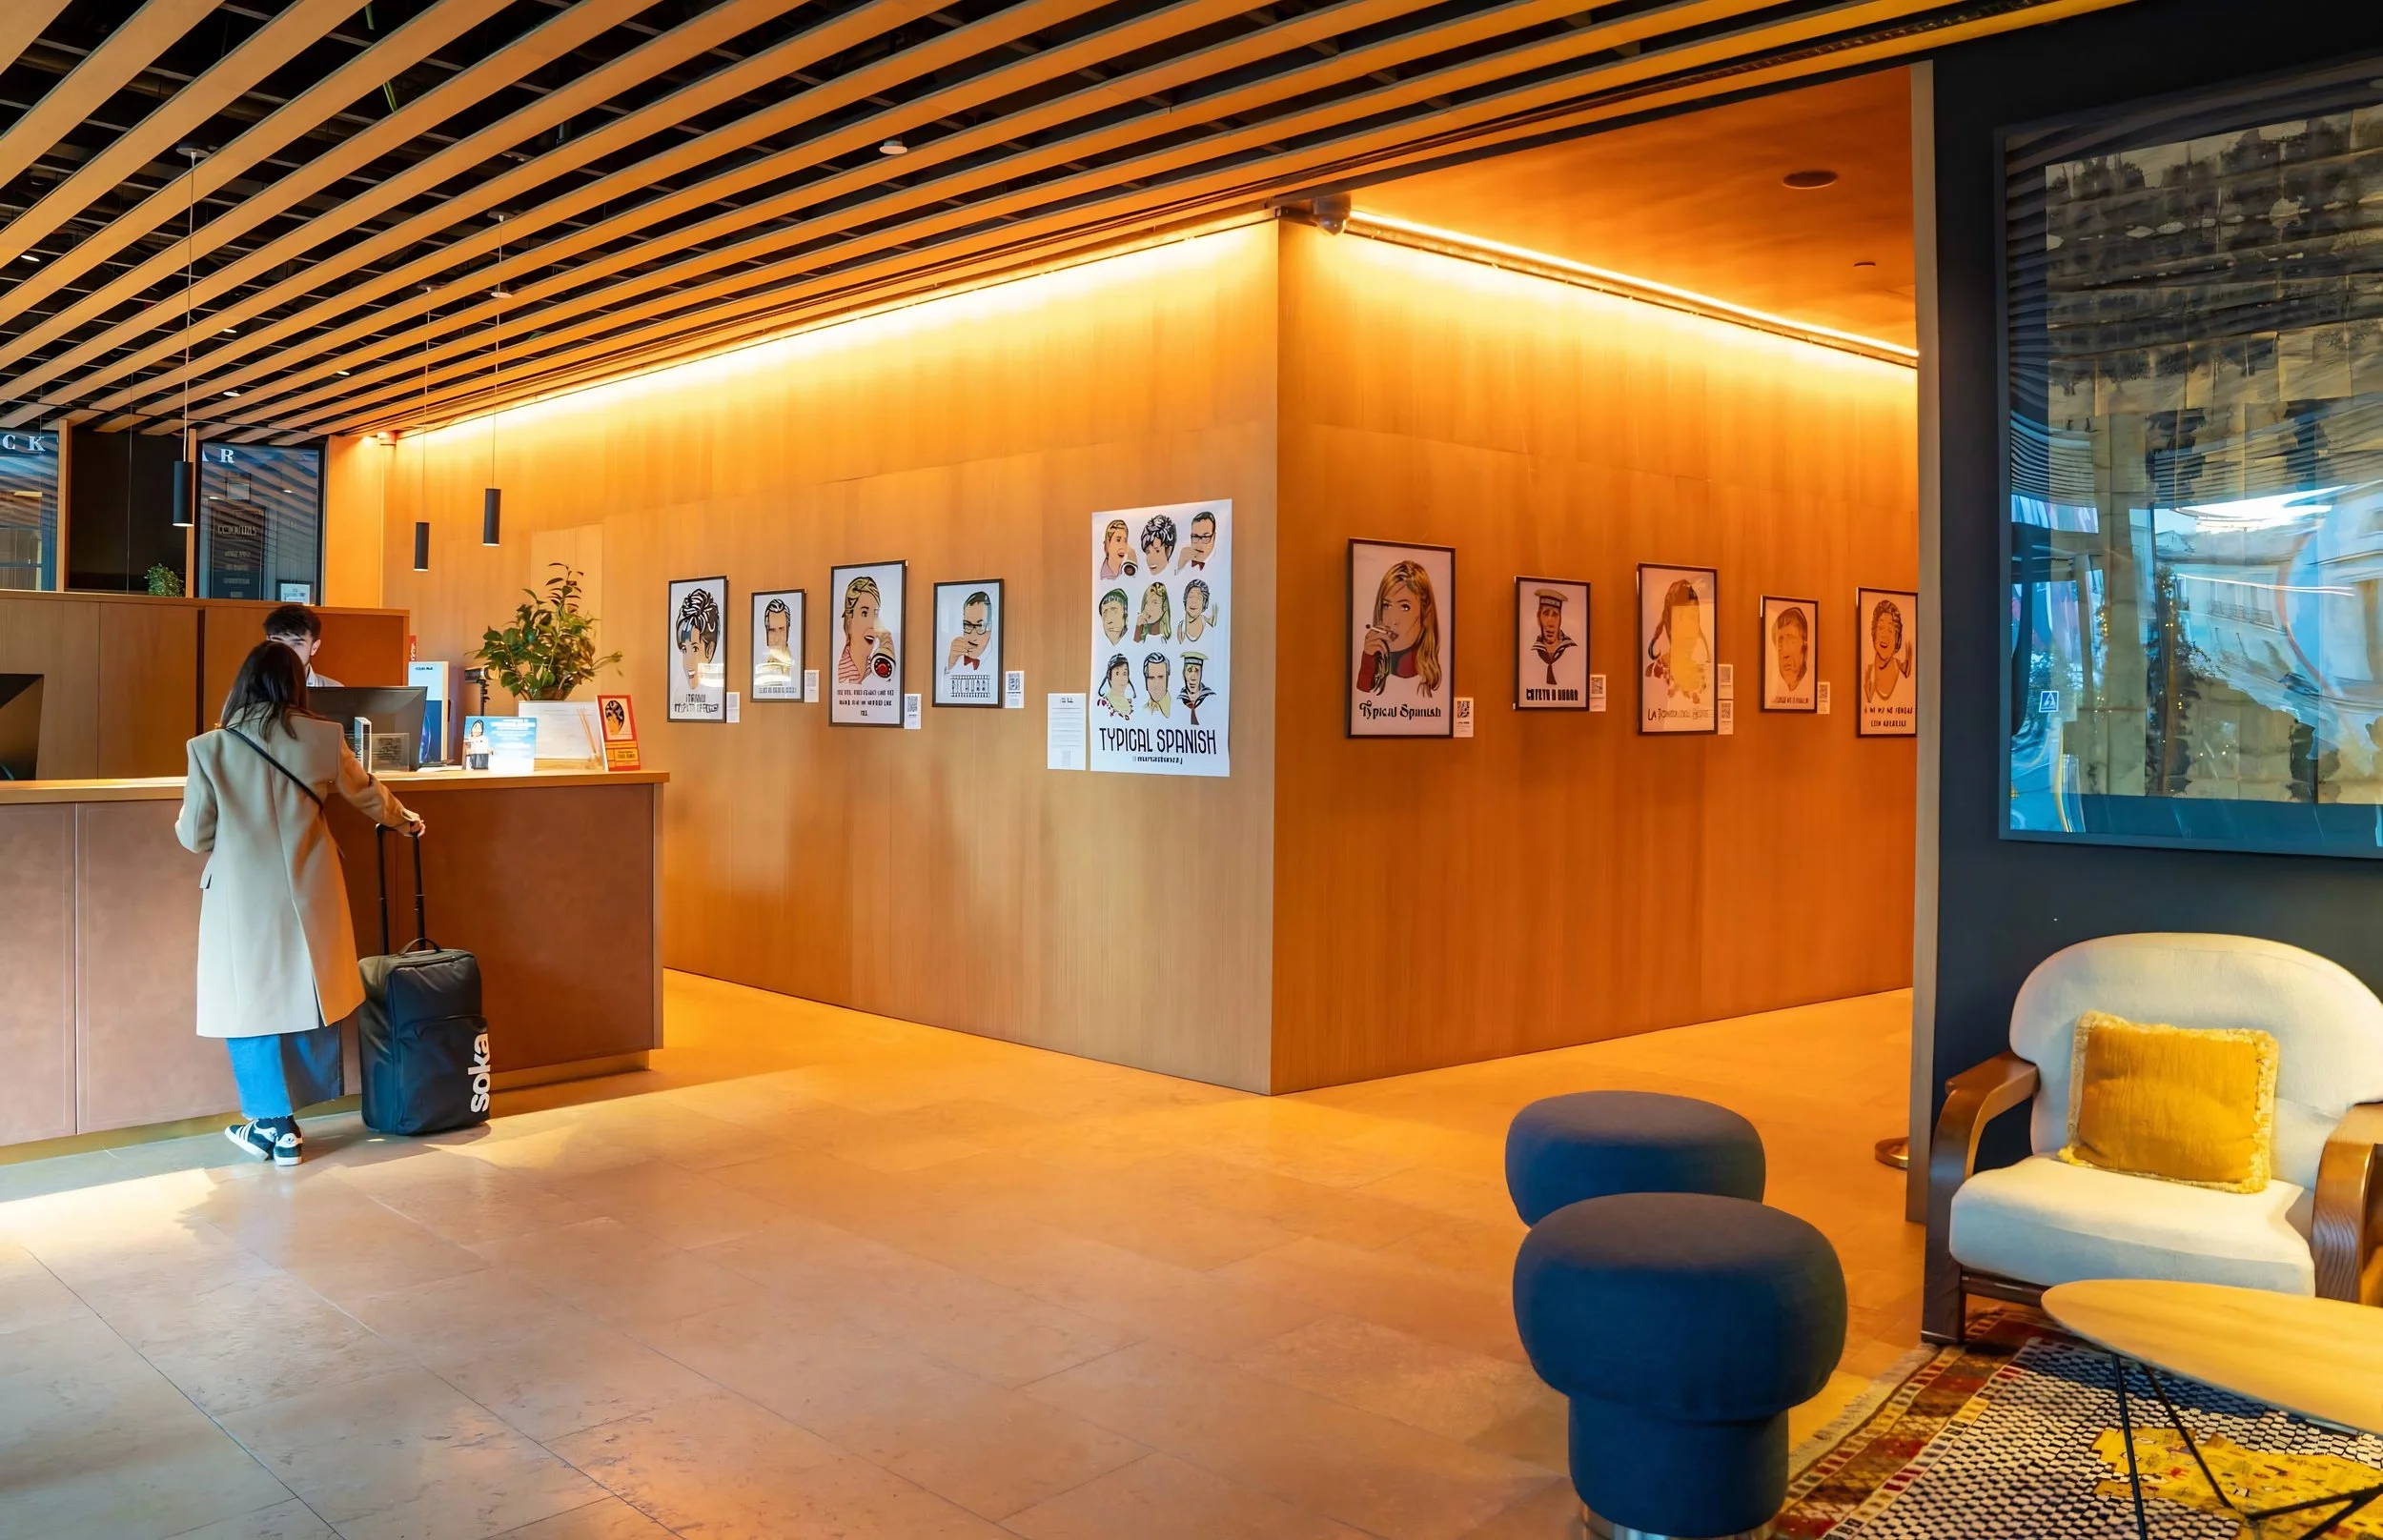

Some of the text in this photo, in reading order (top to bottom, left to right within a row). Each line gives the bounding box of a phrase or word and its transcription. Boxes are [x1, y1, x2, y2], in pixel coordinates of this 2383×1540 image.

[3, 435, 58, 452] CK
[1359, 700, 1441, 720] Typical Spanish
[1099, 727, 1152, 752] TYPICAL
[1157, 729, 1216, 755] SPANISH
[468, 1033, 491, 1113] soka
